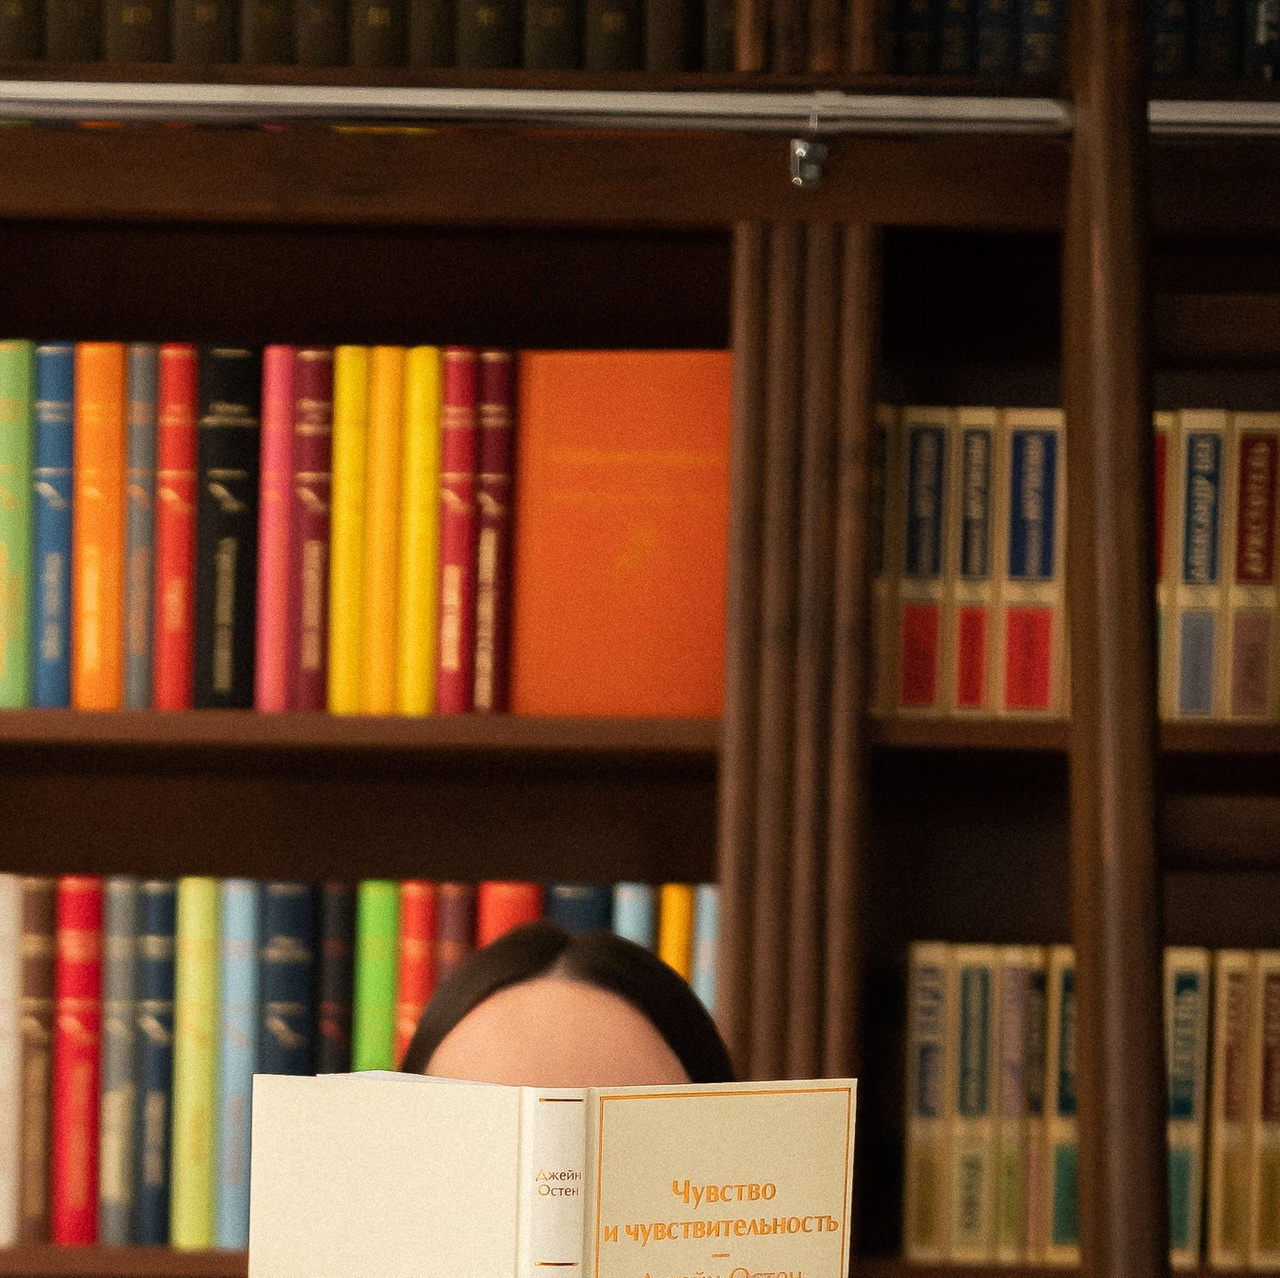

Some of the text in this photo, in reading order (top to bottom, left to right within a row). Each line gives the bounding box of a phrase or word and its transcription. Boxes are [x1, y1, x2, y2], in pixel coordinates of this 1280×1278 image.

[535, 1168, 582, 1182] Джейн
[537, 1183, 579, 1197] Остен
[672, 1179, 777, 1209] Чувство
[603, 1214, 839, 1247] и чувствительность
